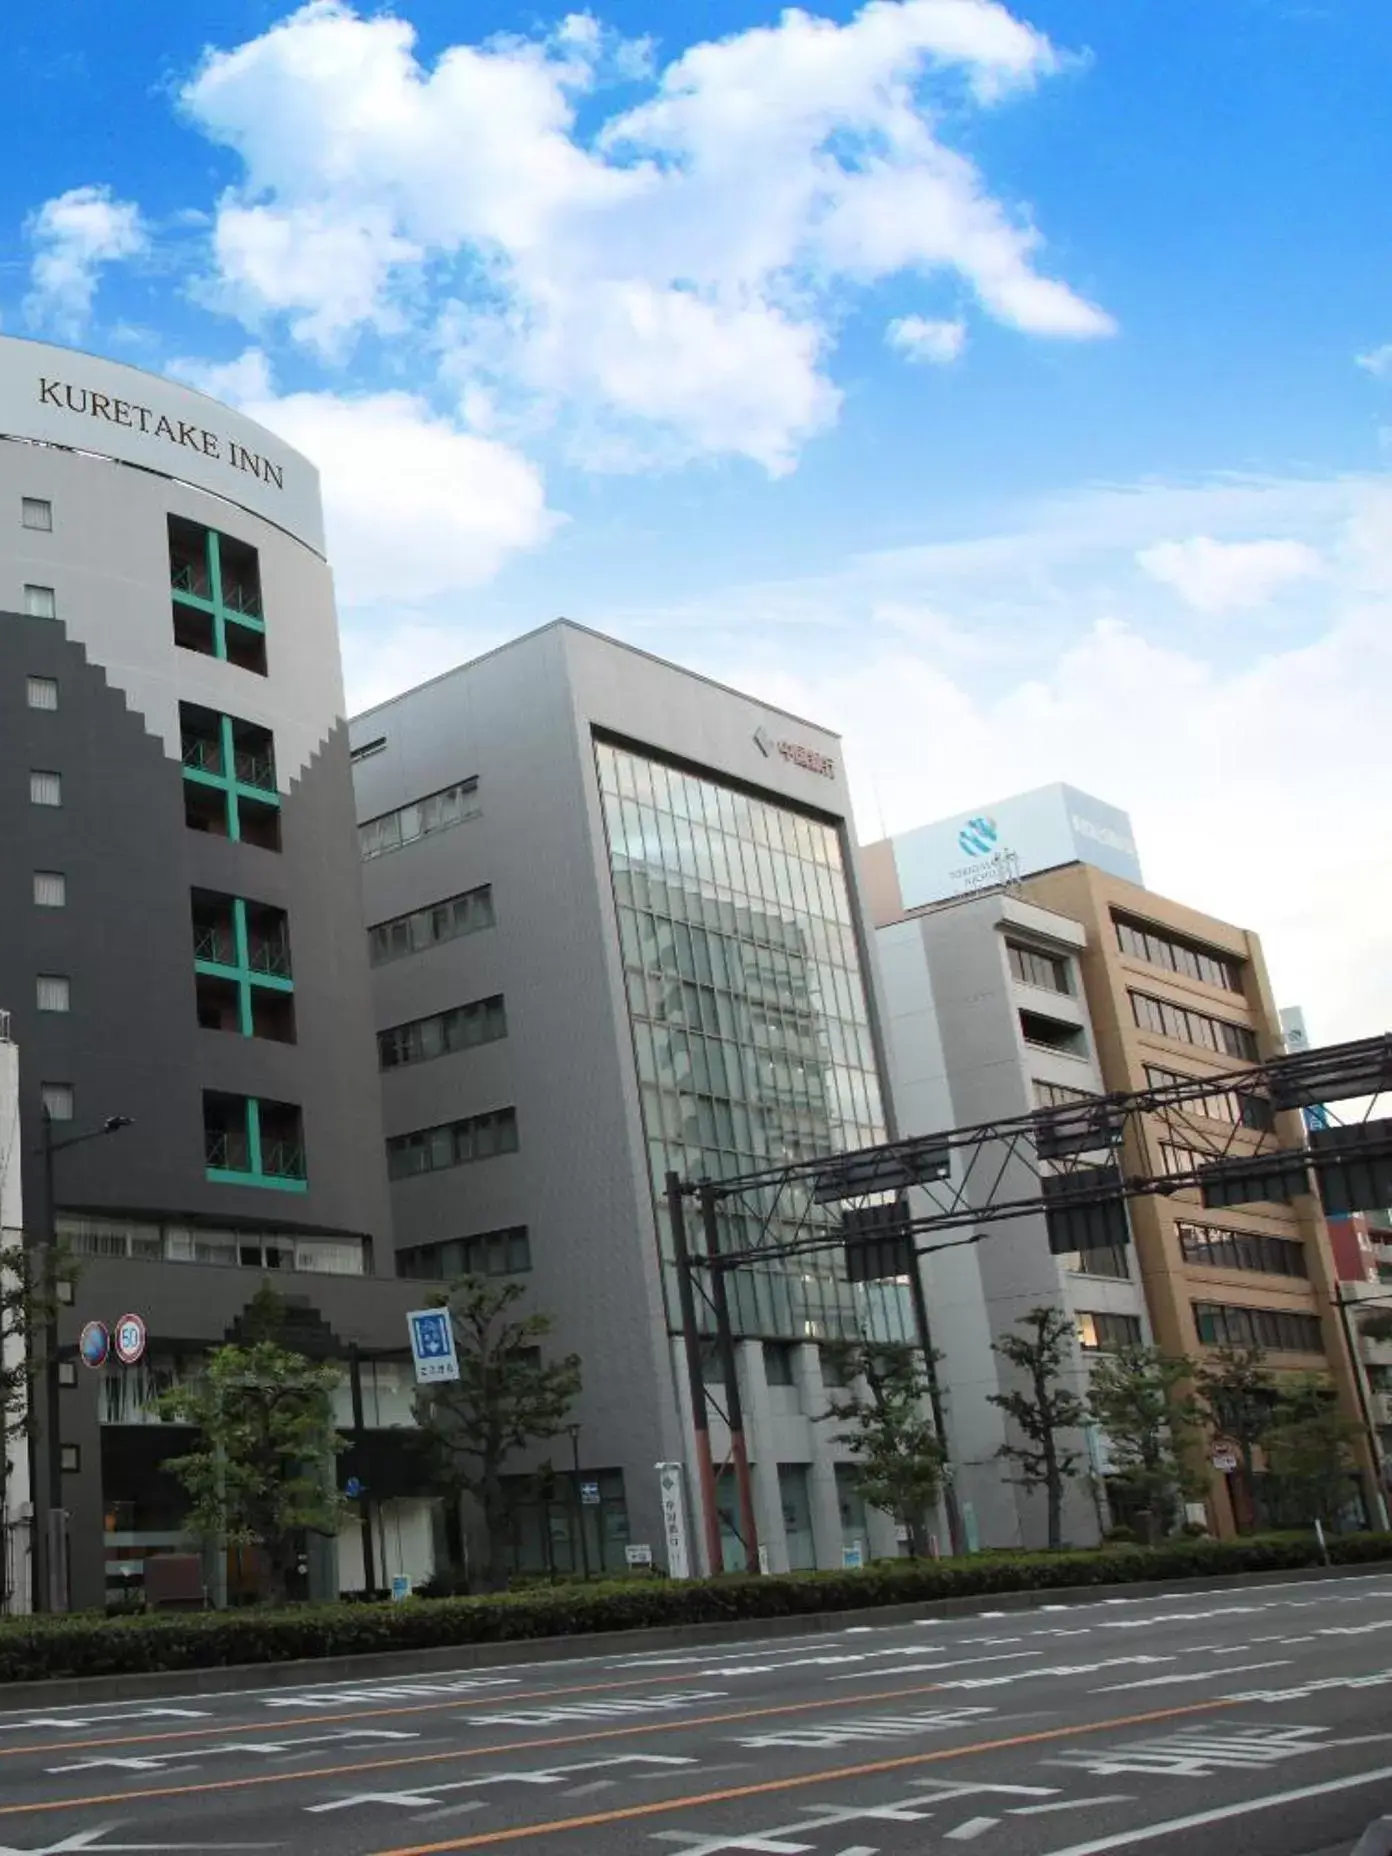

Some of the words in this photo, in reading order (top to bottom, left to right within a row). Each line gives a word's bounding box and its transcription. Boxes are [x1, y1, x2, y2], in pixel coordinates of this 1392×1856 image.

[38, 378, 221, 460] KURETAKE
[228, 440, 284, 490] INN
[122, 1328, 139, 1348] 50
